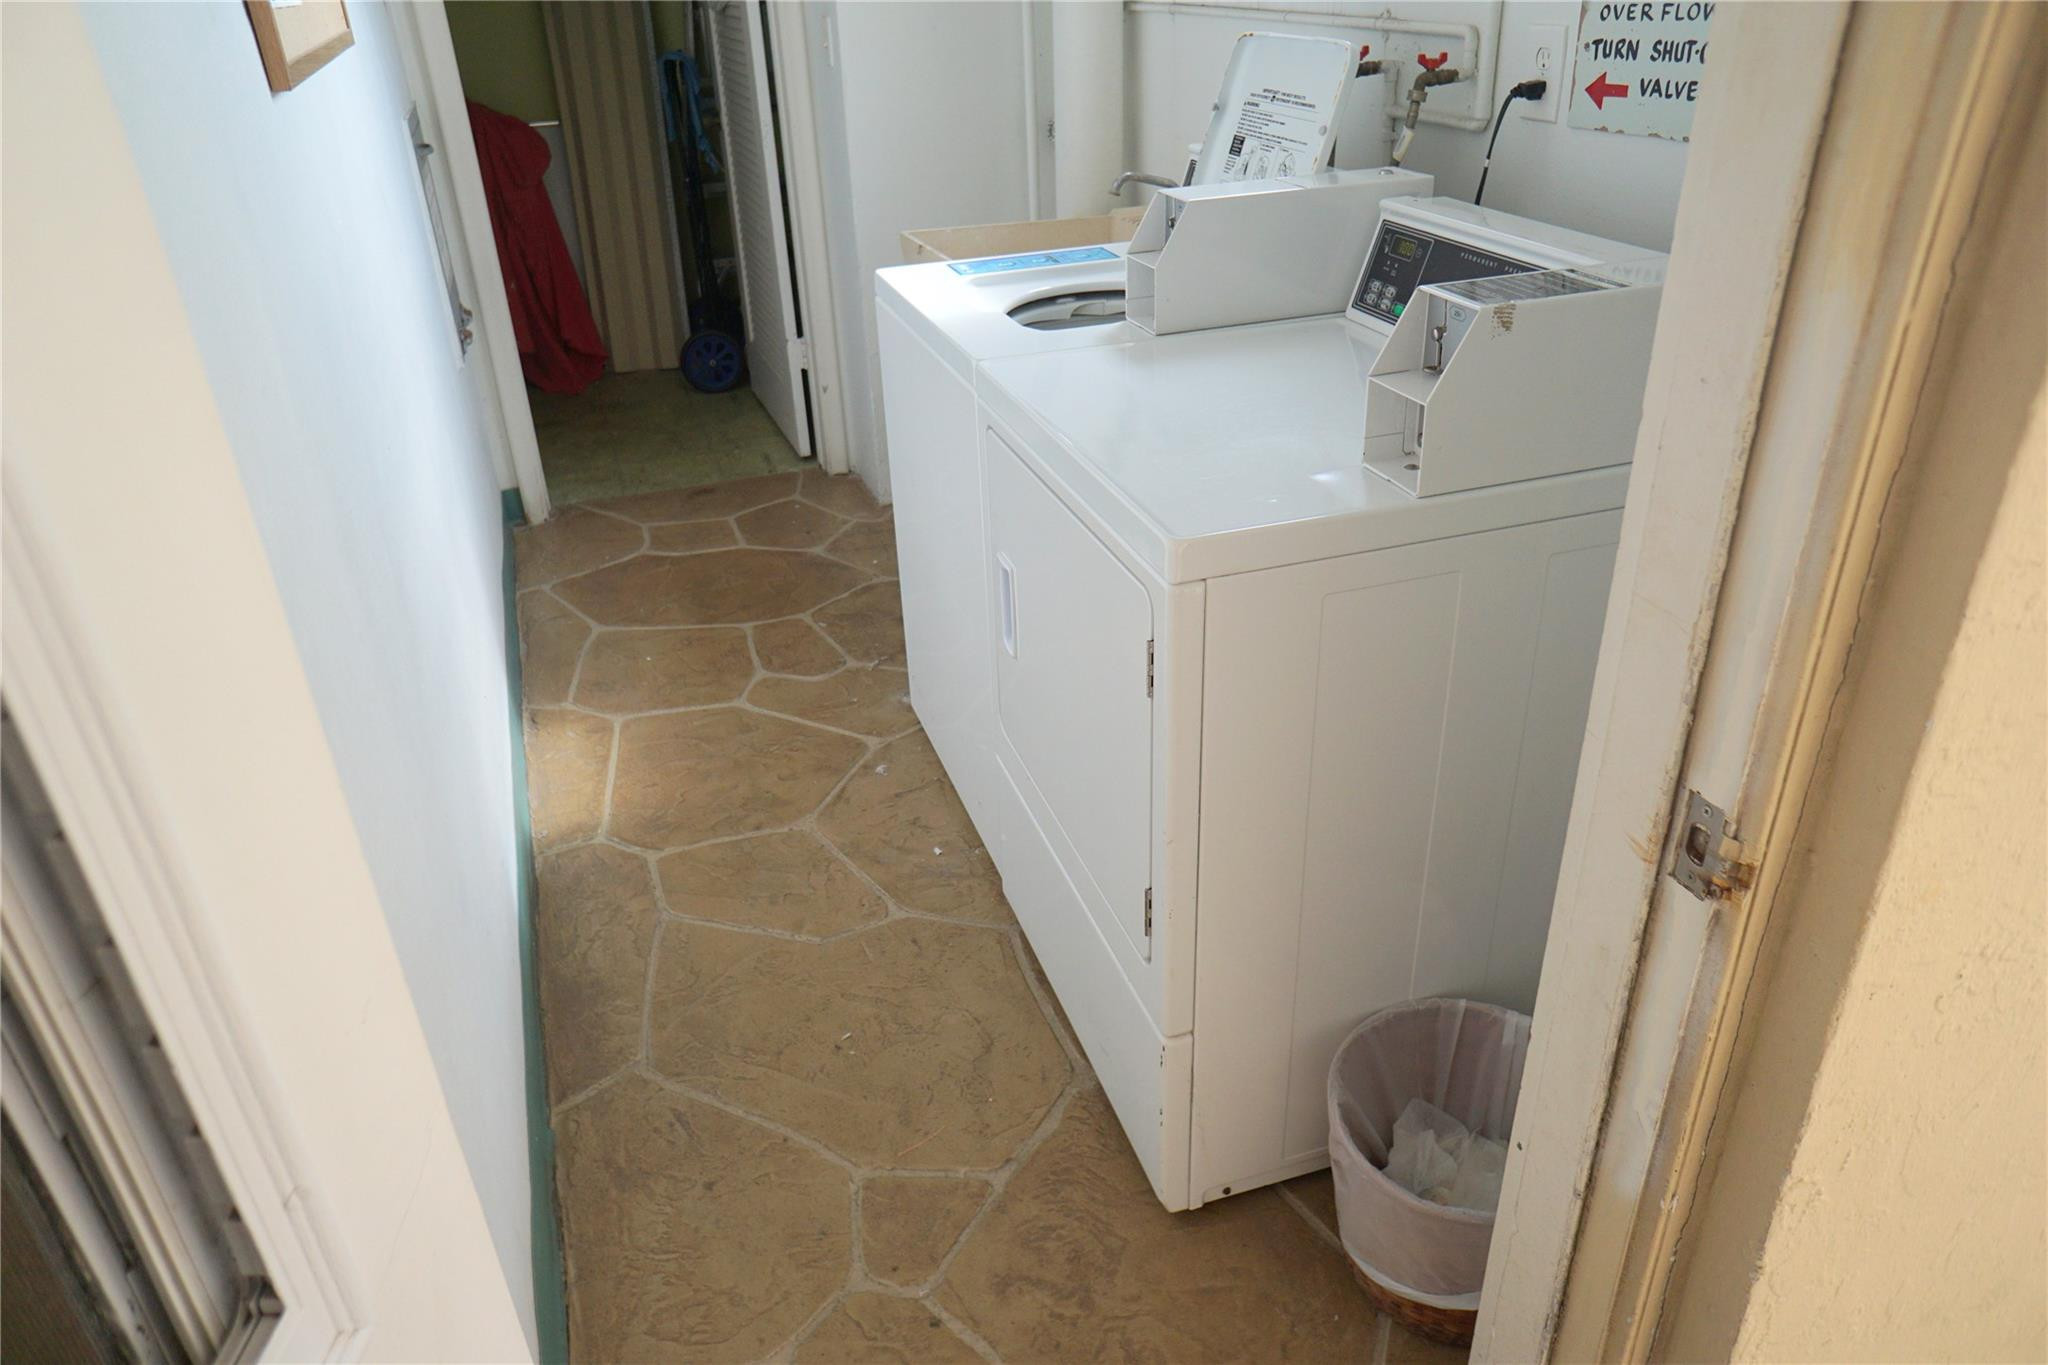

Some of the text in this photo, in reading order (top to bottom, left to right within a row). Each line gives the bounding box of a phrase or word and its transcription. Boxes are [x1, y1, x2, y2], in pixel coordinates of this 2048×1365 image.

[1600, 3, 1654, 21] OVER
[1592, 38, 1640, 61] TURN
[1640, 77, 1698, 101] VALVE
